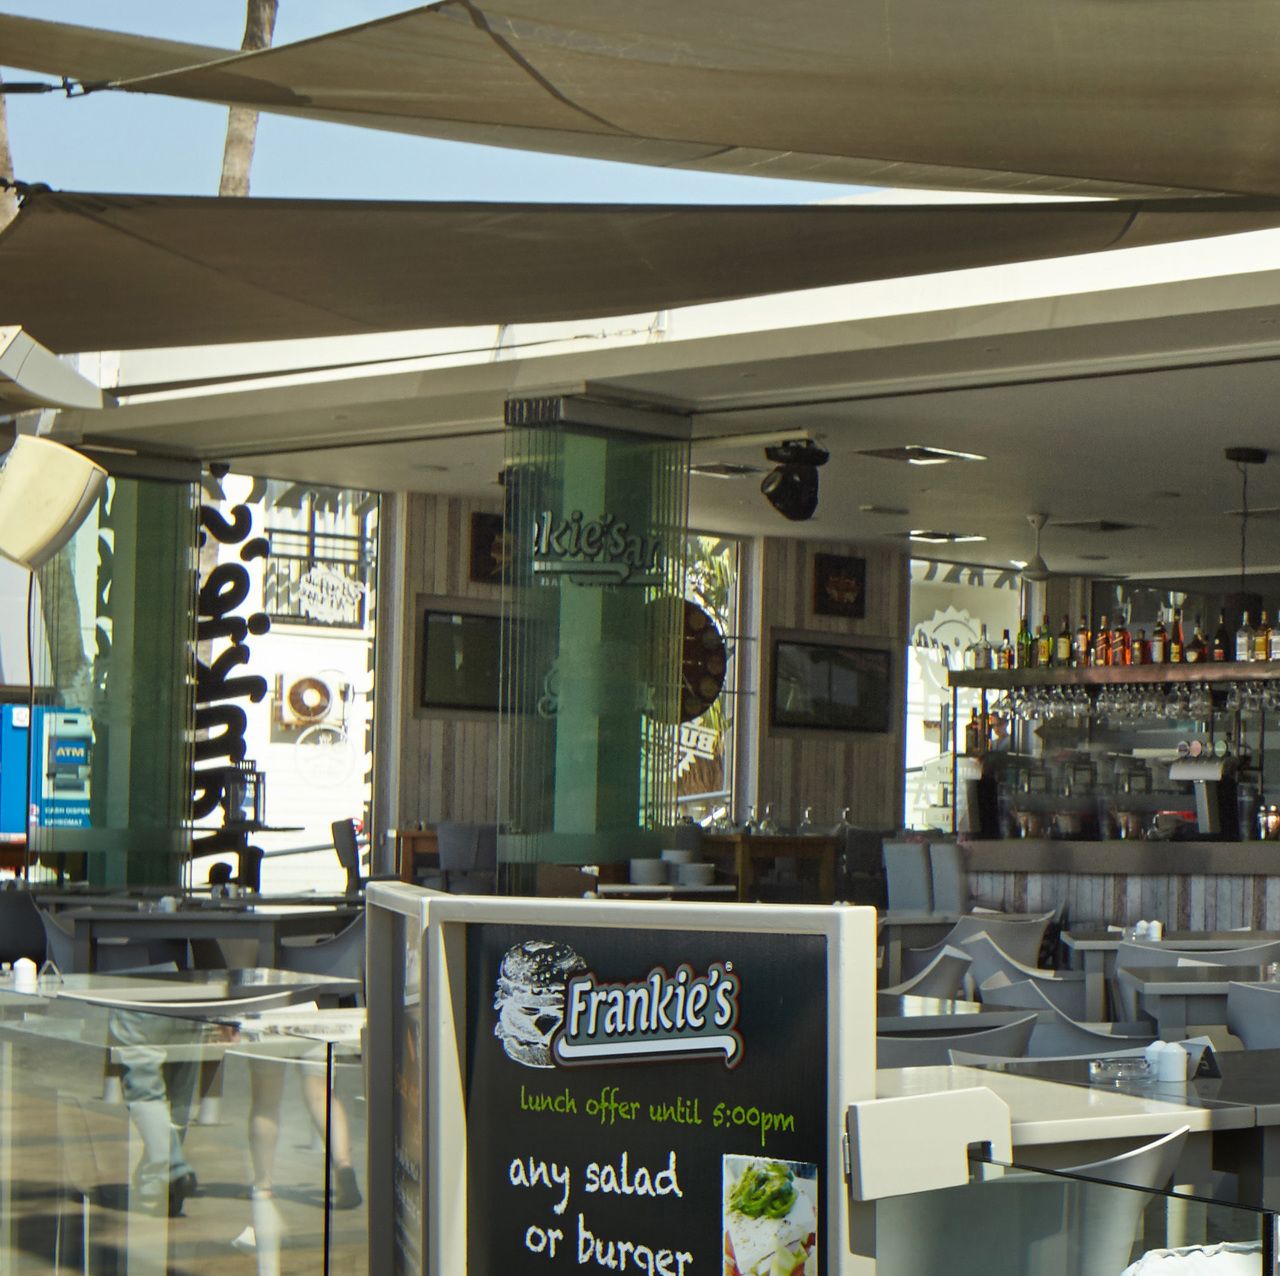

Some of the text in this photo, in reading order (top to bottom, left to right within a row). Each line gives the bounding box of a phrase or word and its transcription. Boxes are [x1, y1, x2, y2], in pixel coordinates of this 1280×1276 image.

[56, 746, 85, 757] ATM
[569, 968, 735, 1038] Frankie's
[521, 1086, 795, 1147] lunch offer until 5:00pm
[509, 1151, 683, 1215] any salad
[526, 1226, 563, 1257] or
